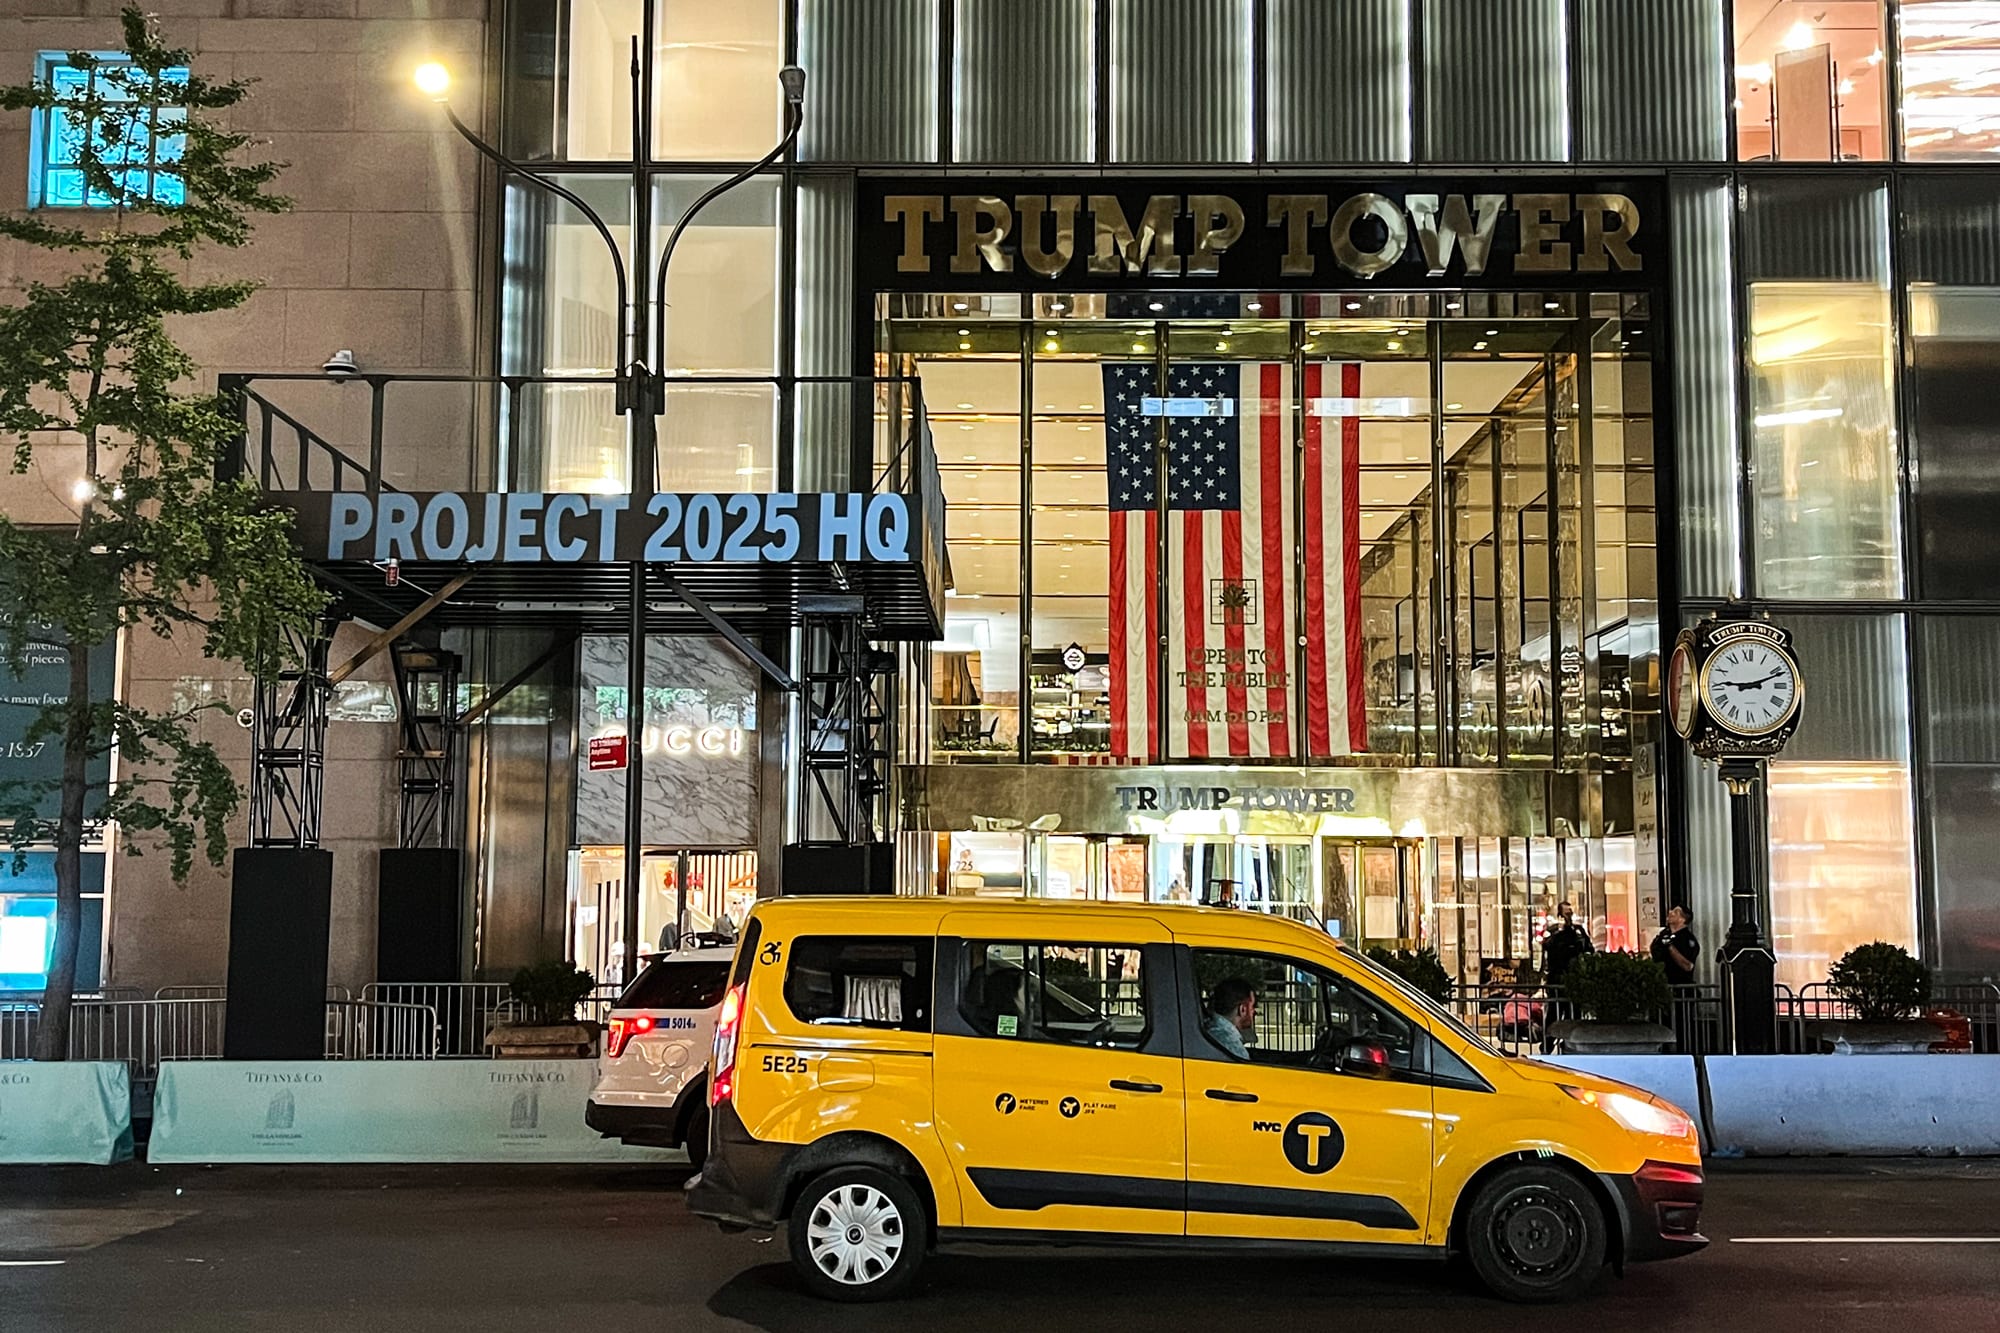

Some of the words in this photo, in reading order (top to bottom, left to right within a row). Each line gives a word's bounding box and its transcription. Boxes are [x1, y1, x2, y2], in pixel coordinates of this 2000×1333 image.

[884, 195, 1245, 278] TRUMP
[1266, 192, 1643, 279] TOWER
[328, 491, 630, 562] PROJECT
[644, 492, 800, 562] 2025
[818, 493, 909, 562] HQ
[1714, 625, 1745, 640] TRUMP
[1748, 625, 1779, 641] TOWER
[31, 654, 65, 667] pieces
[1191, 648, 1244, 665] OPEN
[1247, 648, 1276, 665] TO
[1177, 671, 1216, 688] THE
[1220, 671, 1291, 688] PUBLIC
[1116, 786, 1230, 811] TRUMP
[1236, 787, 1355, 812] TOWER
[672, 1017, 692, 1029] 5014
[762, 1055, 808, 1073] 5E25
[1253, 1121, 1282, 1132] NYC
